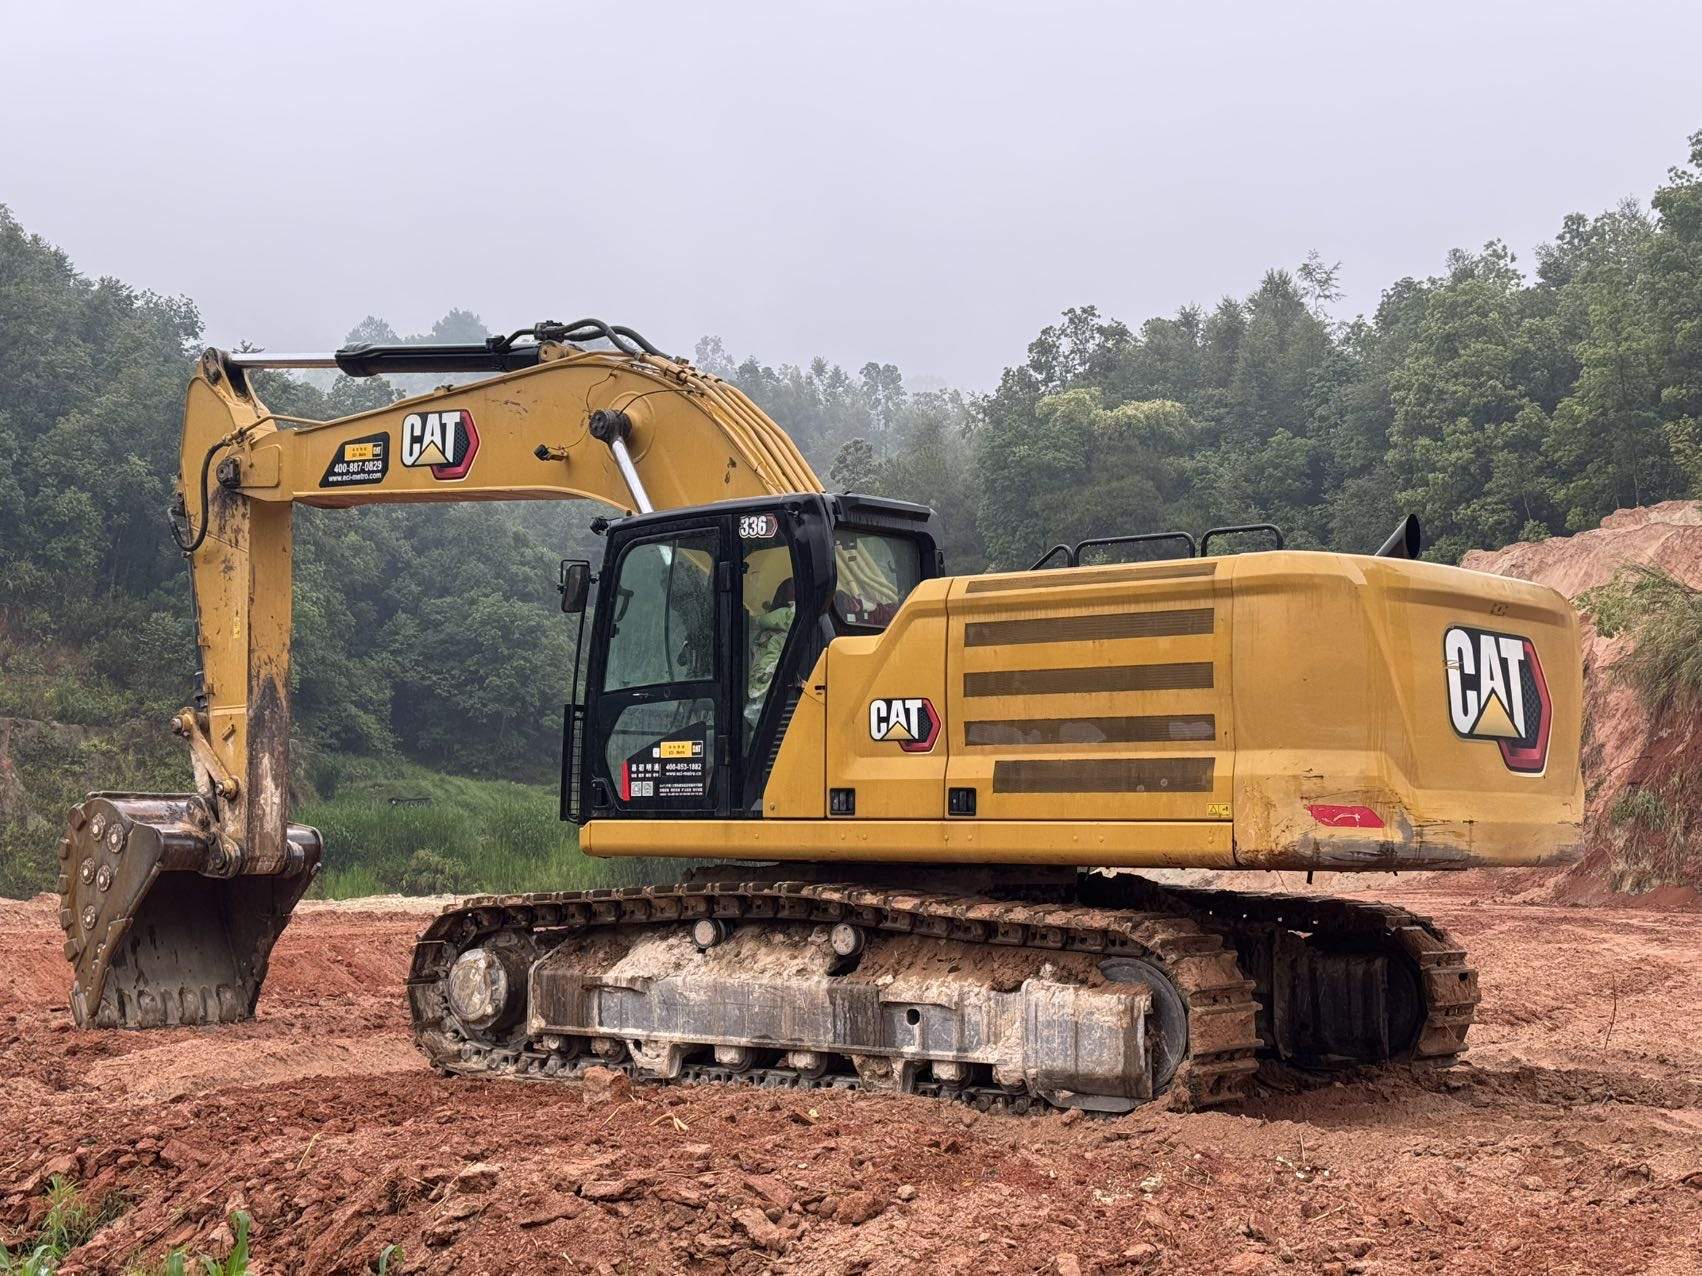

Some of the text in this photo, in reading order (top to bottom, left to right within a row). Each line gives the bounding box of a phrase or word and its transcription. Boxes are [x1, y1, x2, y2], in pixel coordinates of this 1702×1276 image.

[402, 411, 461, 466] CAT
[328, 473, 382, 482] www.eci-metro.com
[334, 461, 382, 473] 400-887-0829
[740, 515, 767, 536] 336
[1445, 628, 1527, 739] CAT
[870, 699, 923, 740] CAT
